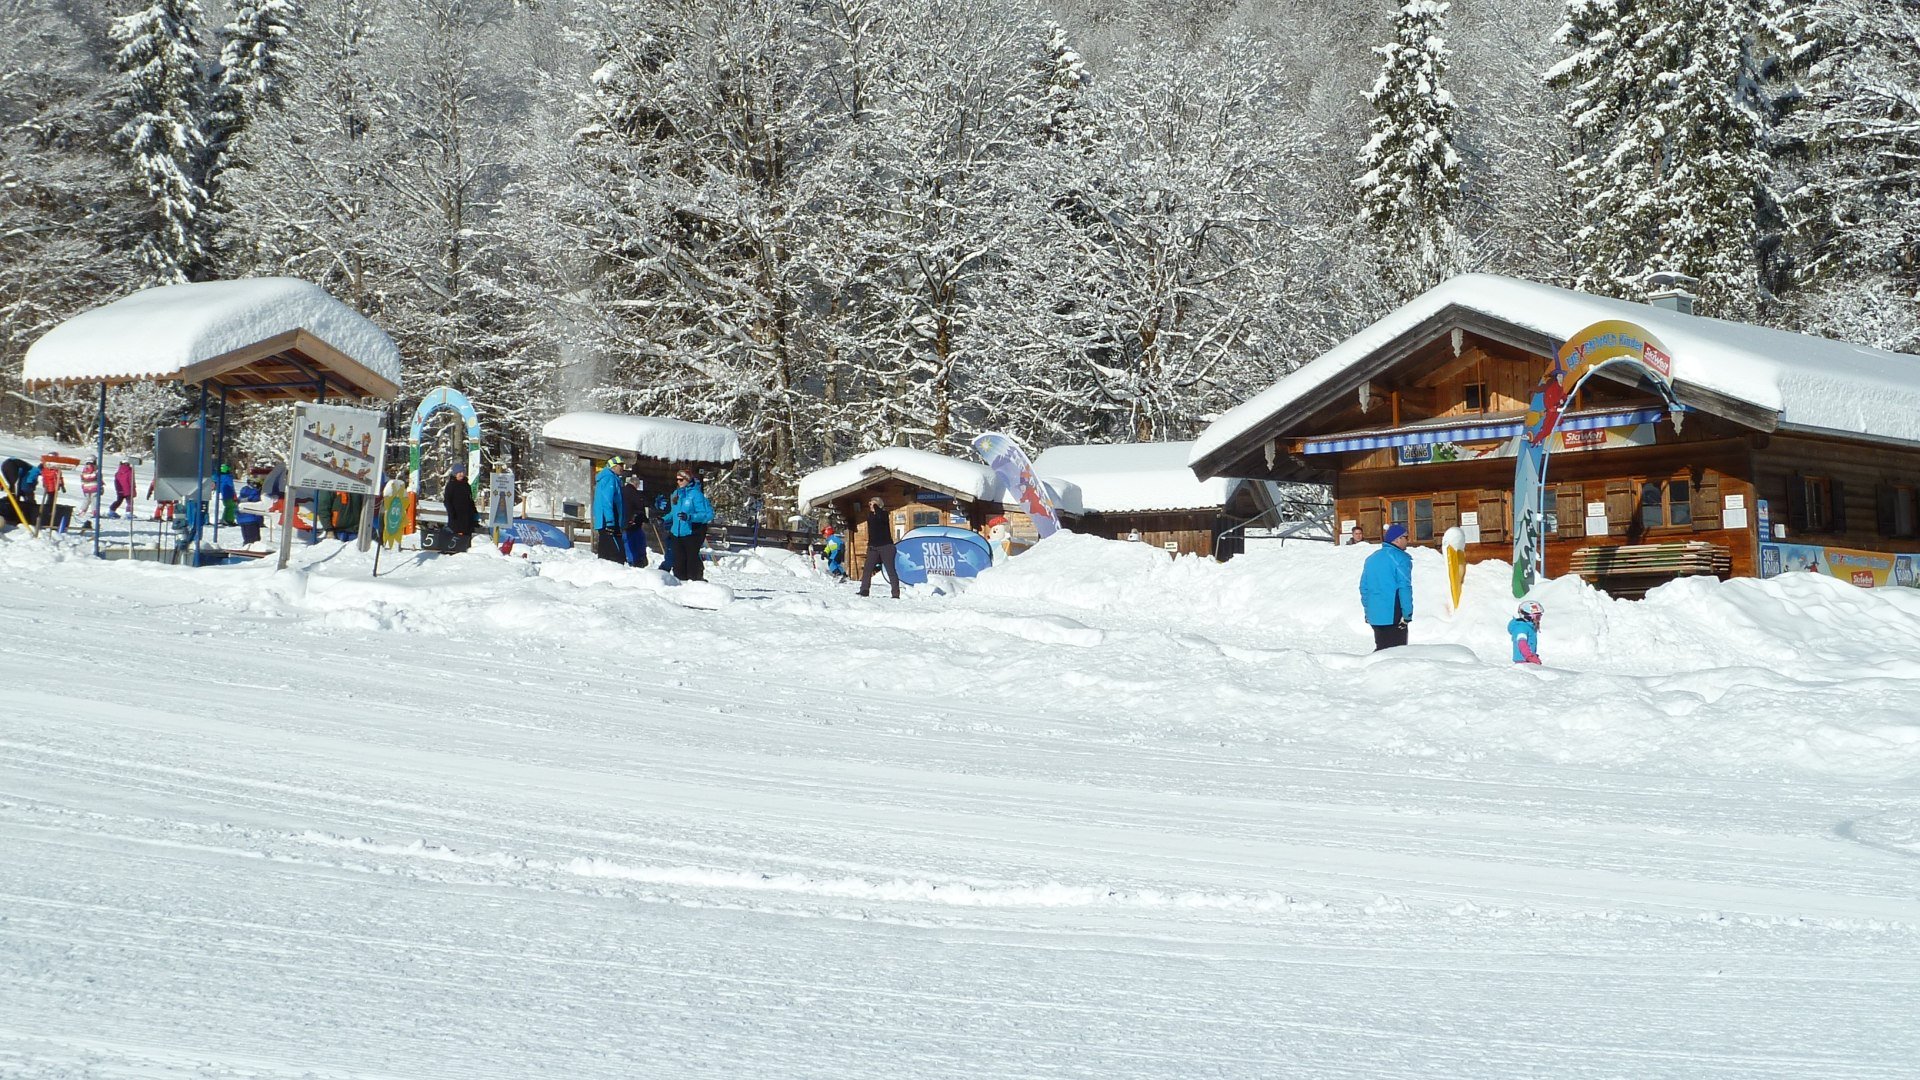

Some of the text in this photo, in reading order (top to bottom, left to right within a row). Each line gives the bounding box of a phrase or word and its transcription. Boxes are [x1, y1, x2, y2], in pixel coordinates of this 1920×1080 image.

[1566, 431, 1603, 441] SkiWelt
[1404, 449, 1428, 459] GIESING
[513, 522, 529, 532] SKI
[422, 533, 435, 547] 5
[447, 536, 458, 549] 5
[922, 542, 941, 556] SKI
[923, 555, 955, 569] BOARD
